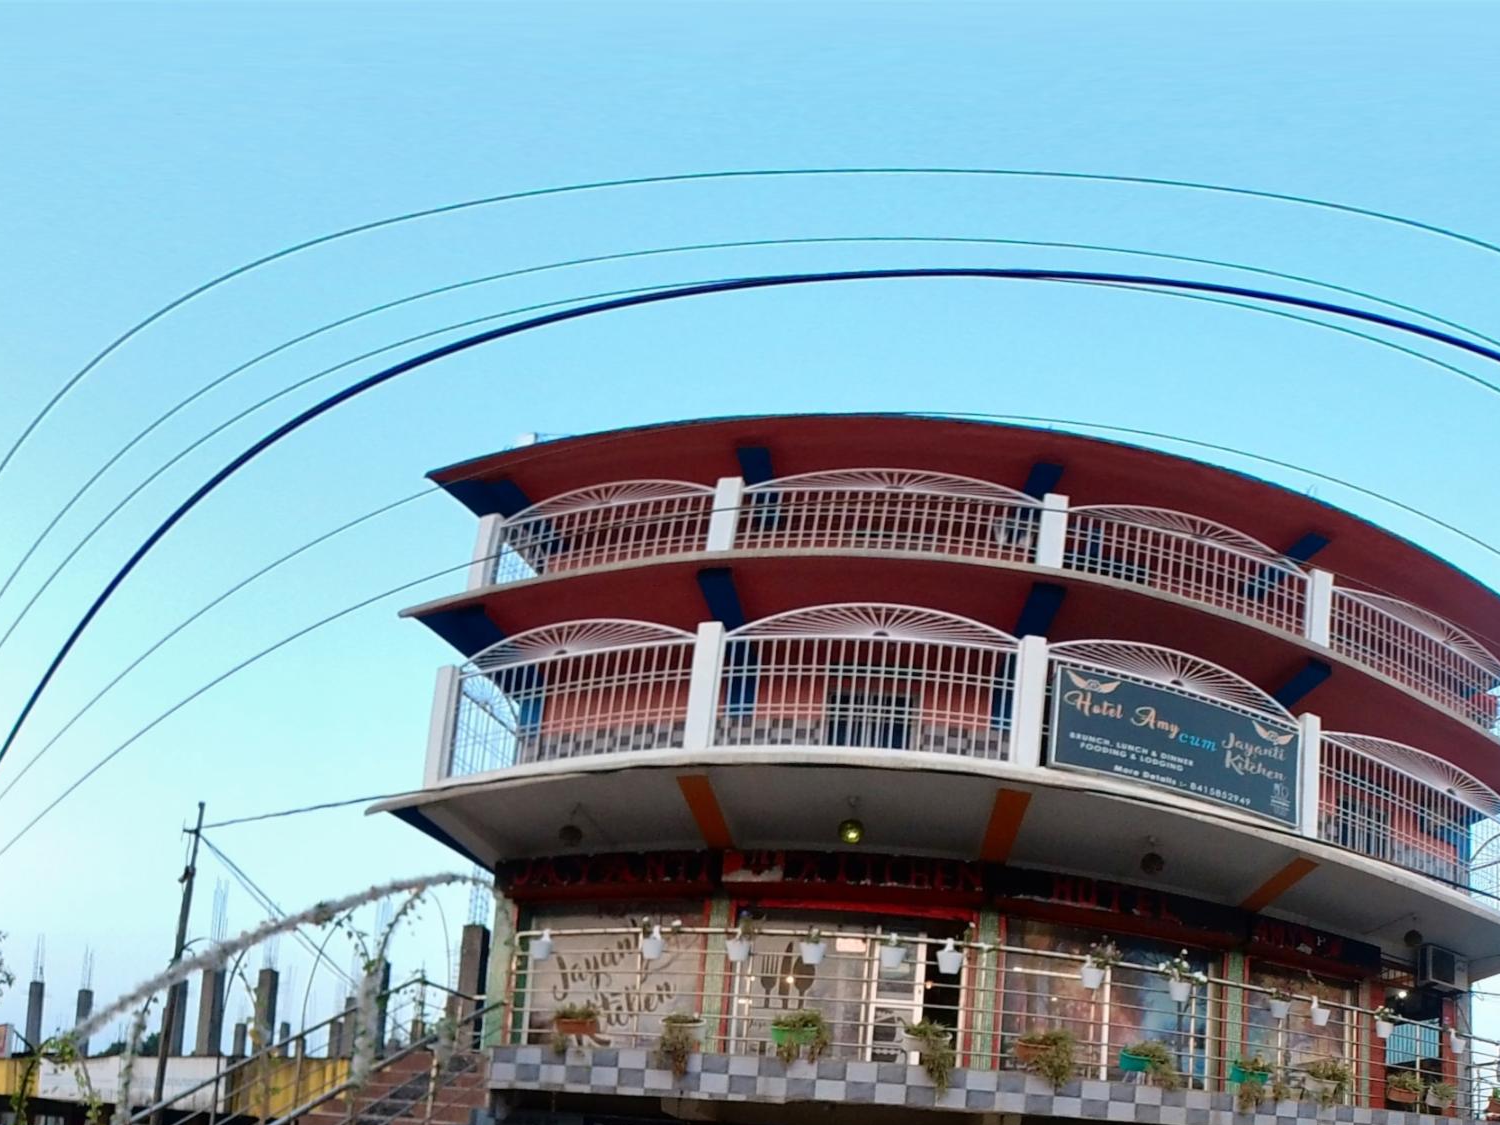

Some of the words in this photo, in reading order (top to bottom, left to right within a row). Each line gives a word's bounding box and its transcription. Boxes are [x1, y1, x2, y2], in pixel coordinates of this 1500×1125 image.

[1063, 690, 1123, 719] Hotel
[1130, 706, 1180, 739] Amy
[1080, 742, 1127, 758] FOODING
[1140, 755, 1184, 772] LODGING
[1116, 742, 1148, 755] LUNCH
[1160, 752, 1194, 766] DINNER
[1179, 733, 1218, 752] cum
[1221, 732, 1285, 761] Jayanti
[1113, 764, 1140, 777] More
[1142, 771, 1177, 785] Details
[1224, 750, 1286, 780] Kitchen
